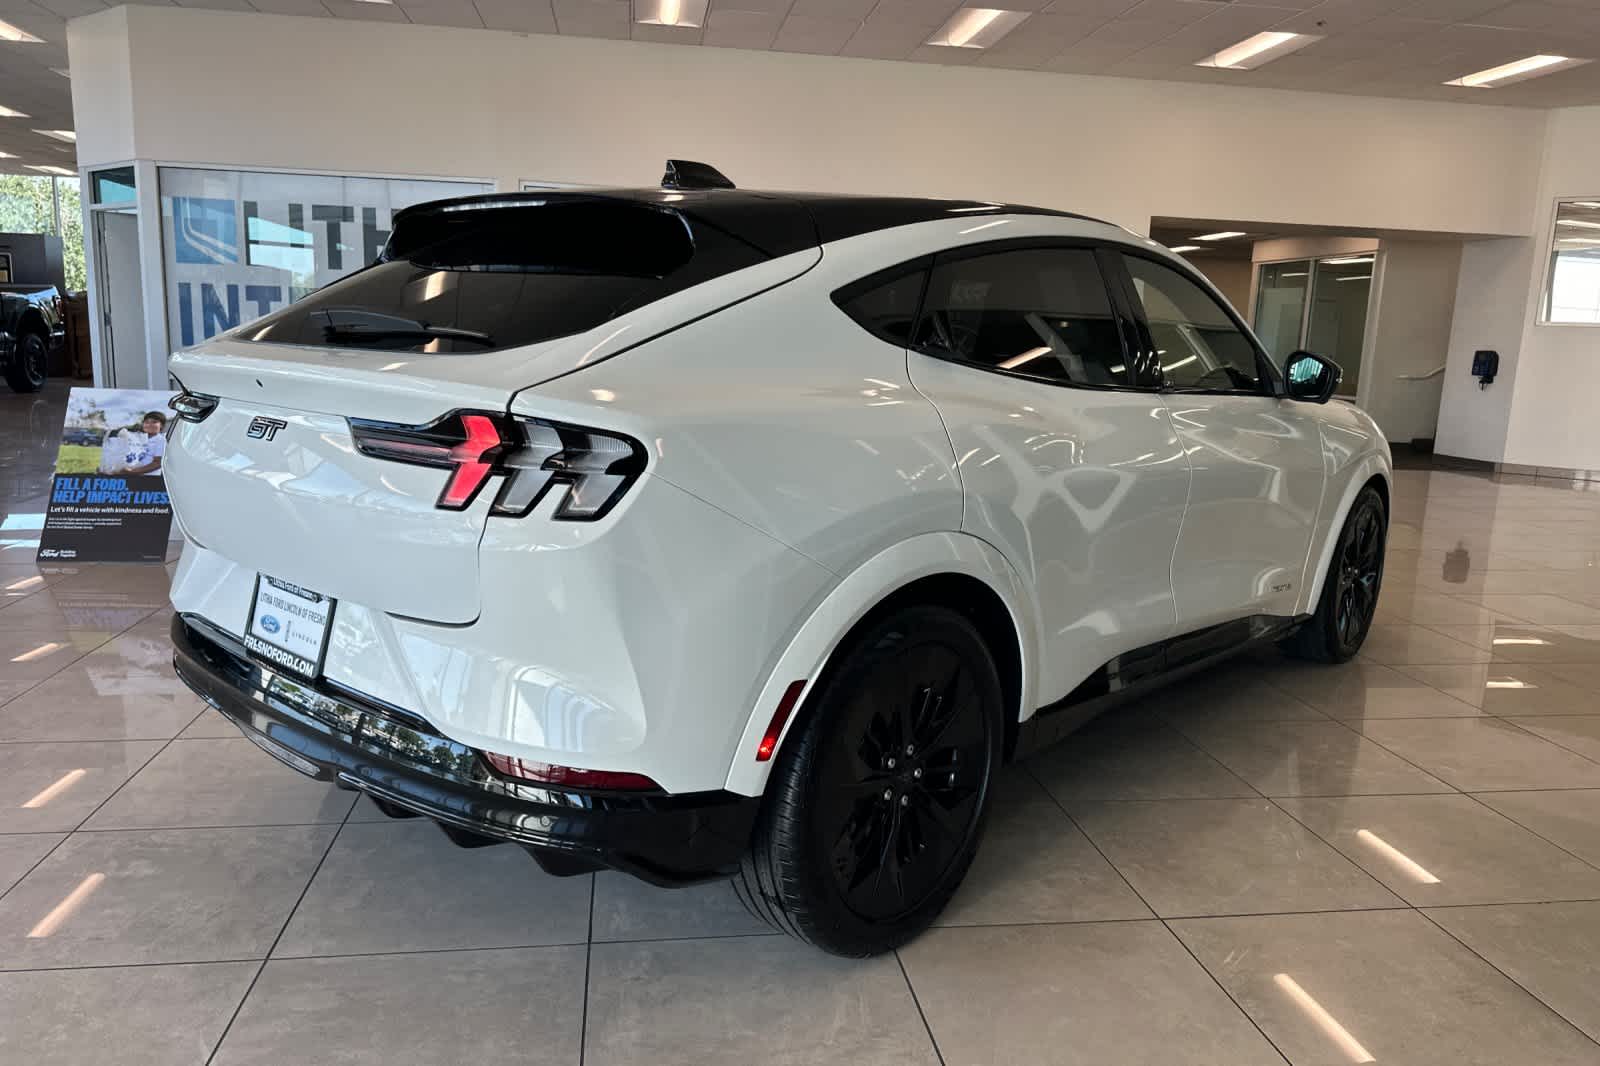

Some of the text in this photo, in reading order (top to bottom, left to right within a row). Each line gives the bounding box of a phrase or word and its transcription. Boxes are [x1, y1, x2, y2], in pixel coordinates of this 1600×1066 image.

[247, 415, 288, 441] GT
[56, 477, 129, 491] FILL A FORD.
[53, 490, 85, 503] HELP
[87, 490, 135, 504] IMPACT
[40, 549, 59, 557] Ford
[243, 634, 314, 676] FRESNOFORD.COM
